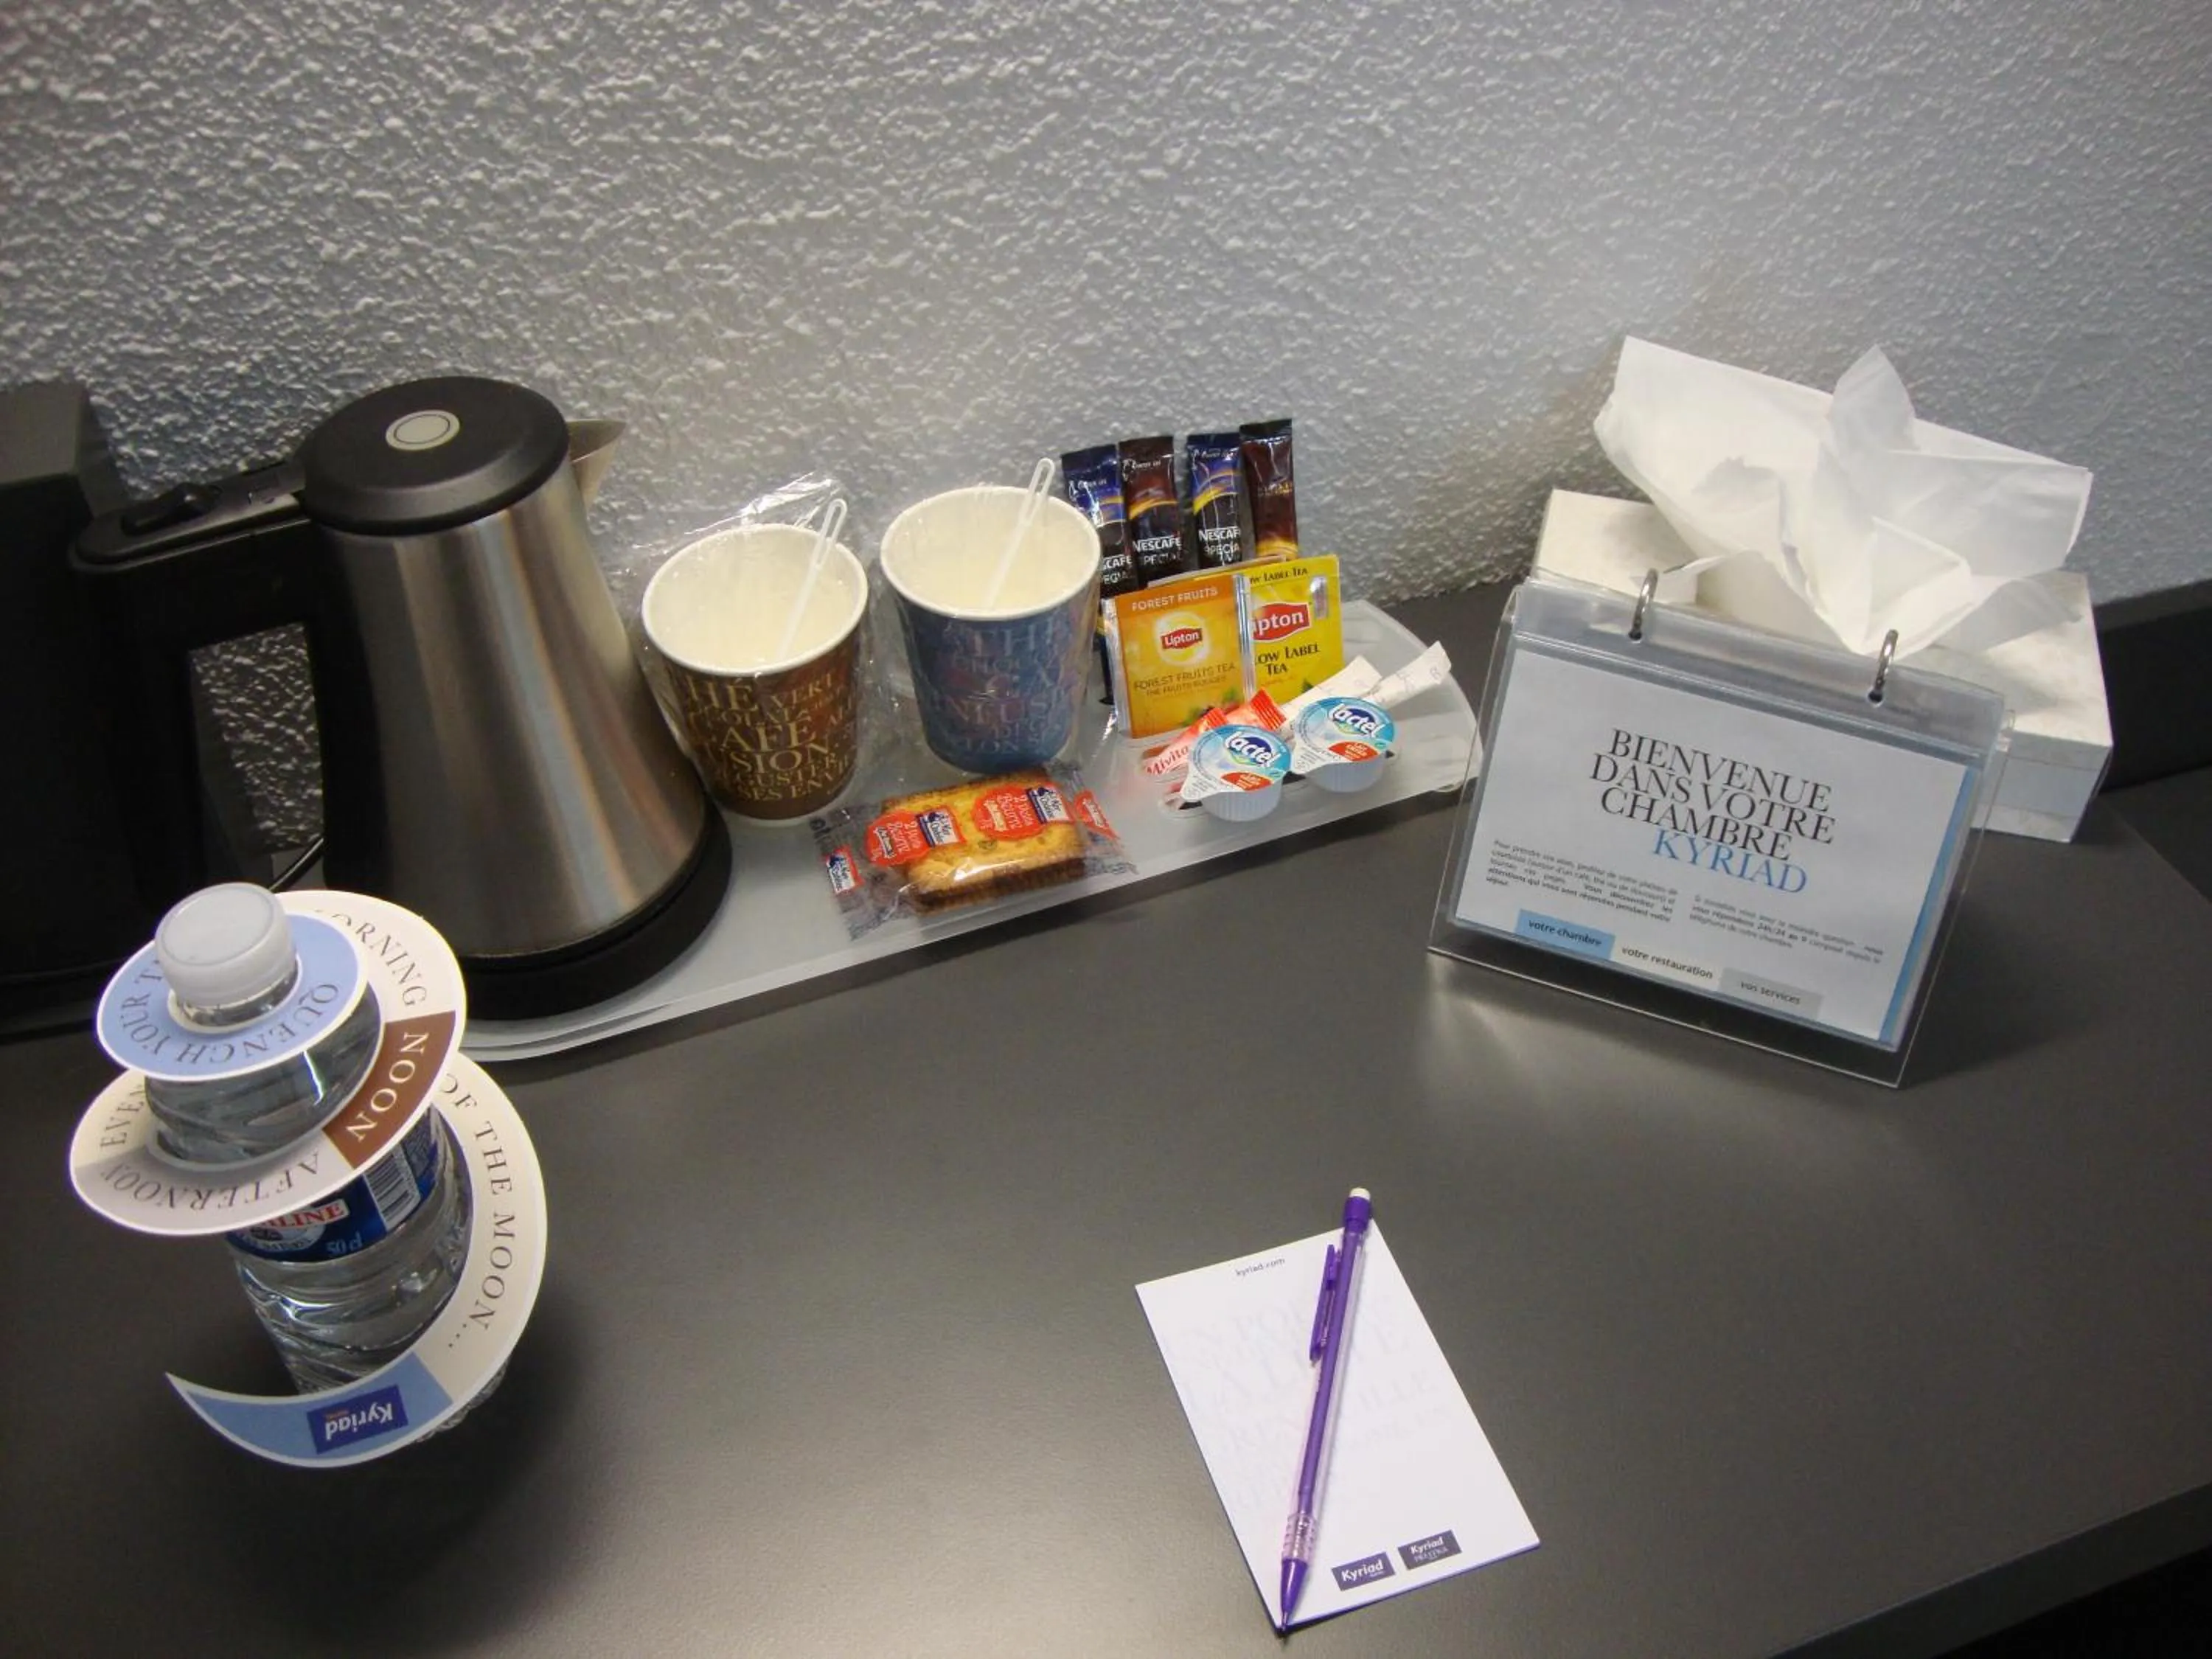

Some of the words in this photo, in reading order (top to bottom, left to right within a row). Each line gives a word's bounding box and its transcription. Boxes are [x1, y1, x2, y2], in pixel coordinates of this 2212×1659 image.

[1197, 526, 1241, 542] NESCAF
[1132, 594, 1174, 611] FOREST
[1178, 587, 1218, 602] FRUITS
[1164, 630, 1200, 647] Lipton
[1253, 611, 1304, 636] ipton
[1284, 641, 1321, 658] LABEL
[1265, 662, 1288, 676] TEA
[1328, 703, 1386, 740] lactel
[1223, 731, 1282, 769] lactel
[1609, 728, 1832, 812] BIENVENUE
[1590, 753, 1692, 803] DANS
[1701, 782, 1835, 844] VOTRE
[1601, 787, 1792, 860] CHAMBRE
[1652, 829, 1808, 894] KYRIAD
[1528, 919, 1556, 935] votre
[1557, 927, 1602, 947] chambre
[331, 913, 428, 1008] RNING
[1621, 946, 1649, 961] votre
[1650, 954, 1713, 979] restauration
[1740, 981, 1758, 992] vos
[1760, 987, 1801, 1005] services
[119, 992, 172, 1057] YOUR
[175, 982, 339, 1065] QUENCH
[345, 1032, 429, 1142] NOON
[100, 1085, 146, 1148] EVEN
[439, 1073, 478, 1111] OF
[473, 1120, 513, 1197] THE
[1234, 1258, 1286, 1278] kyriad.com
[324, 1402, 394, 1441] Kyriad
[1410, 1536, 1444, 1555] Kyriad
[1341, 1559, 1384, 1582] Kyriad
